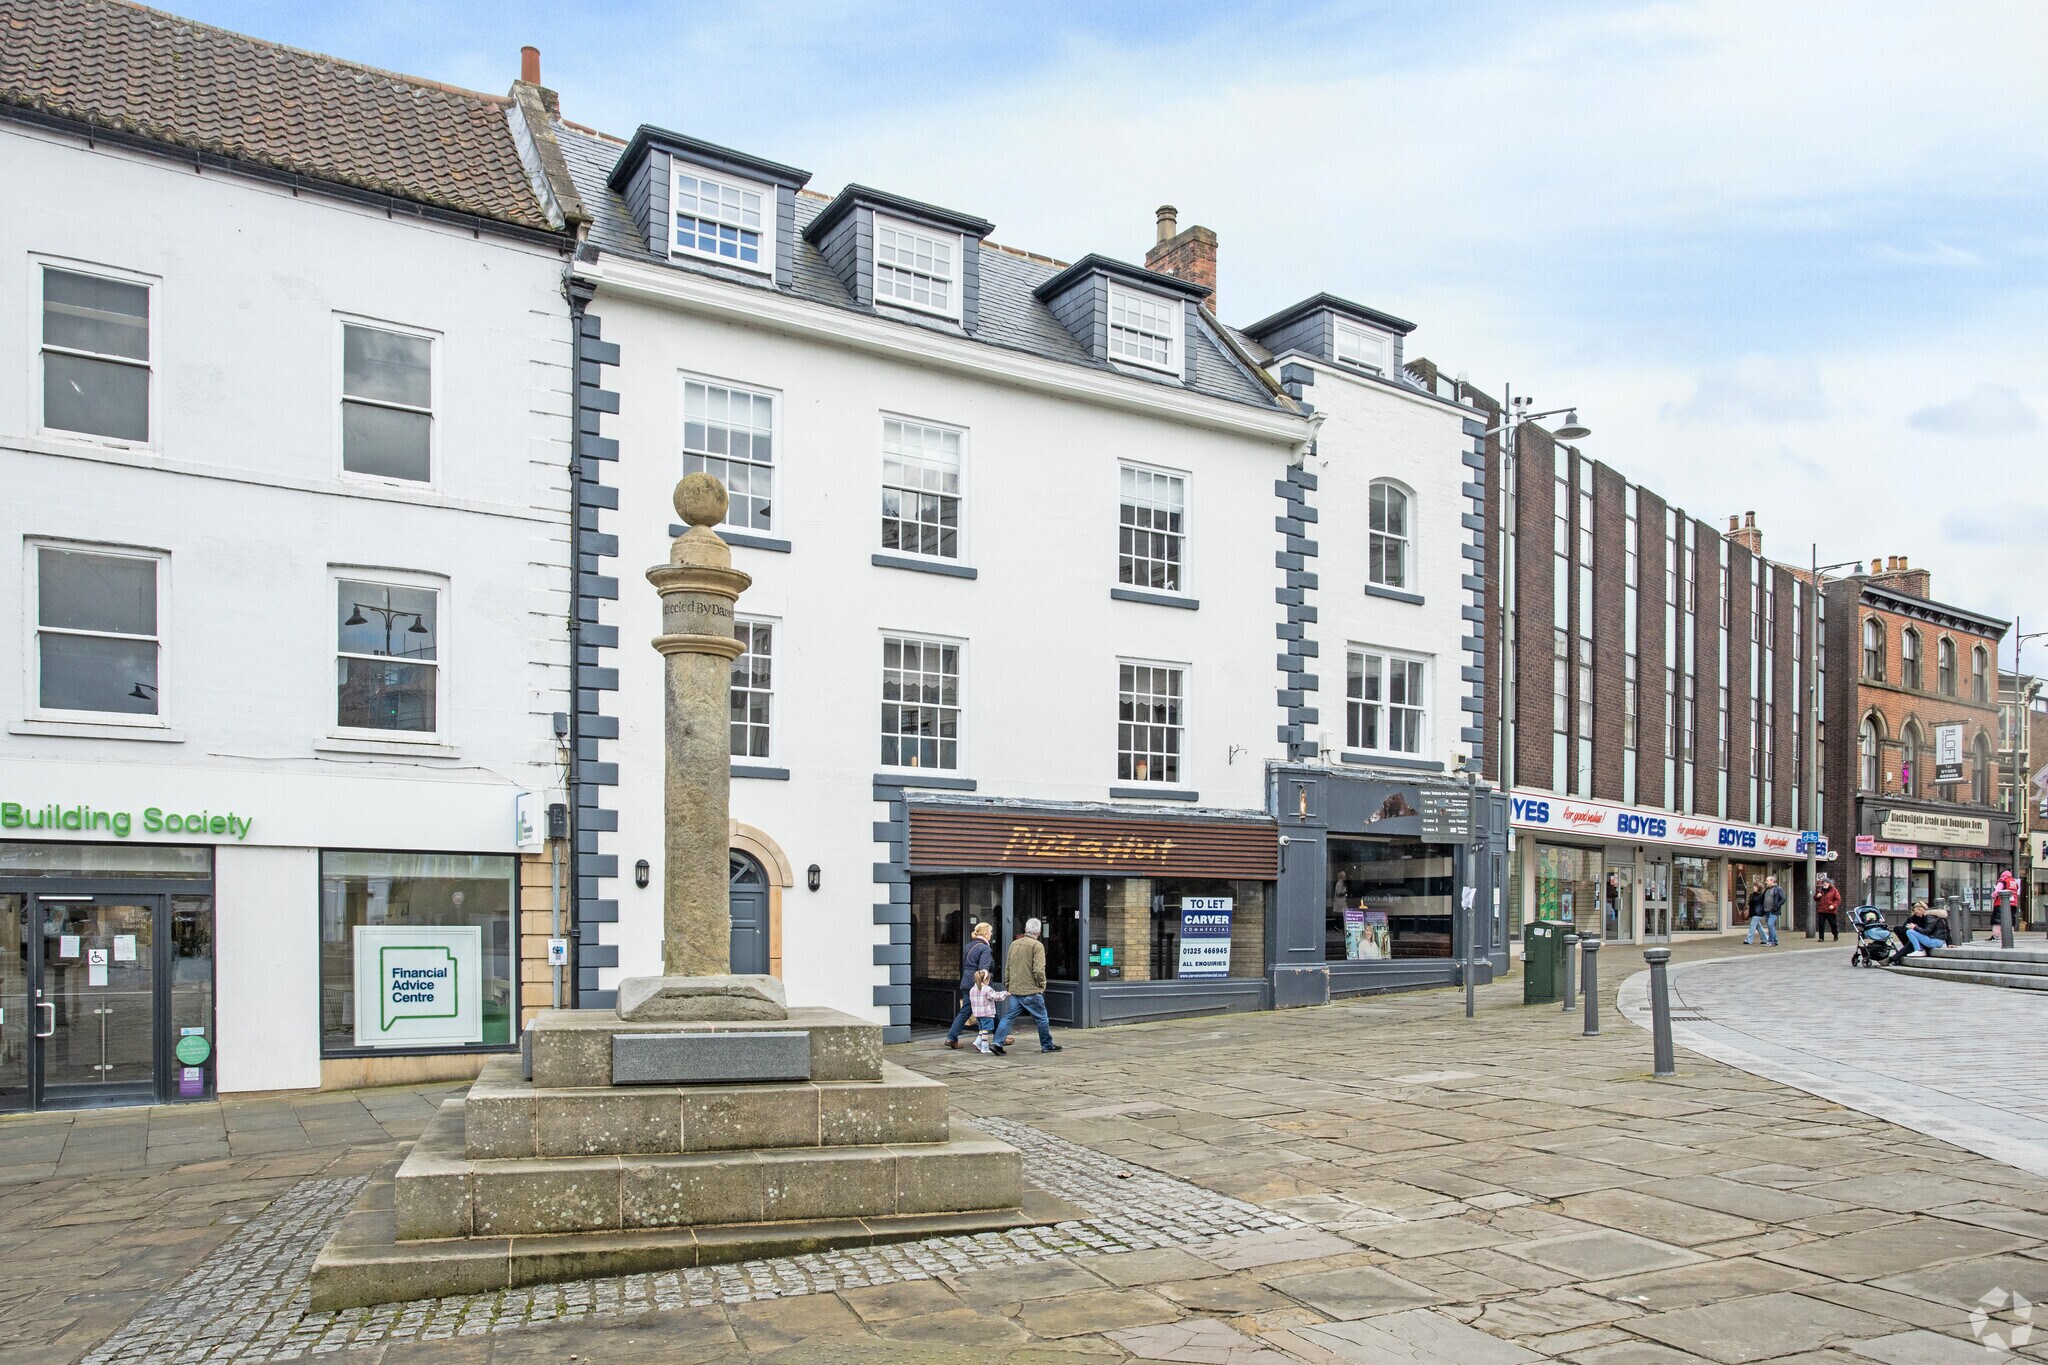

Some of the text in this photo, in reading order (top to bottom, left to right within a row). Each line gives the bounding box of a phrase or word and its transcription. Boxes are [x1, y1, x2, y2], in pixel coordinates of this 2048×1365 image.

[1944, 733, 1956, 762] LOFT
[1510, 797, 1549, 823] YES
[1573, 809, 1588, 823] good
[1, 802, 253, 840] Building Society
[1617, 813, 1667, 838] BOYES
[1718, 827, 1757, 848] BOYES
[1795, 838, 1827, 857] BES
[1190, 899, 1225, 909] TO LET
[1184, 914, 1230, 925] CARVER
[1183, 947, 1202, 955] 01325
[392, 967, 448, 979] Financial
[392, 979, 435, 991] Advice
[392, 992, 435, 1003] Centre
